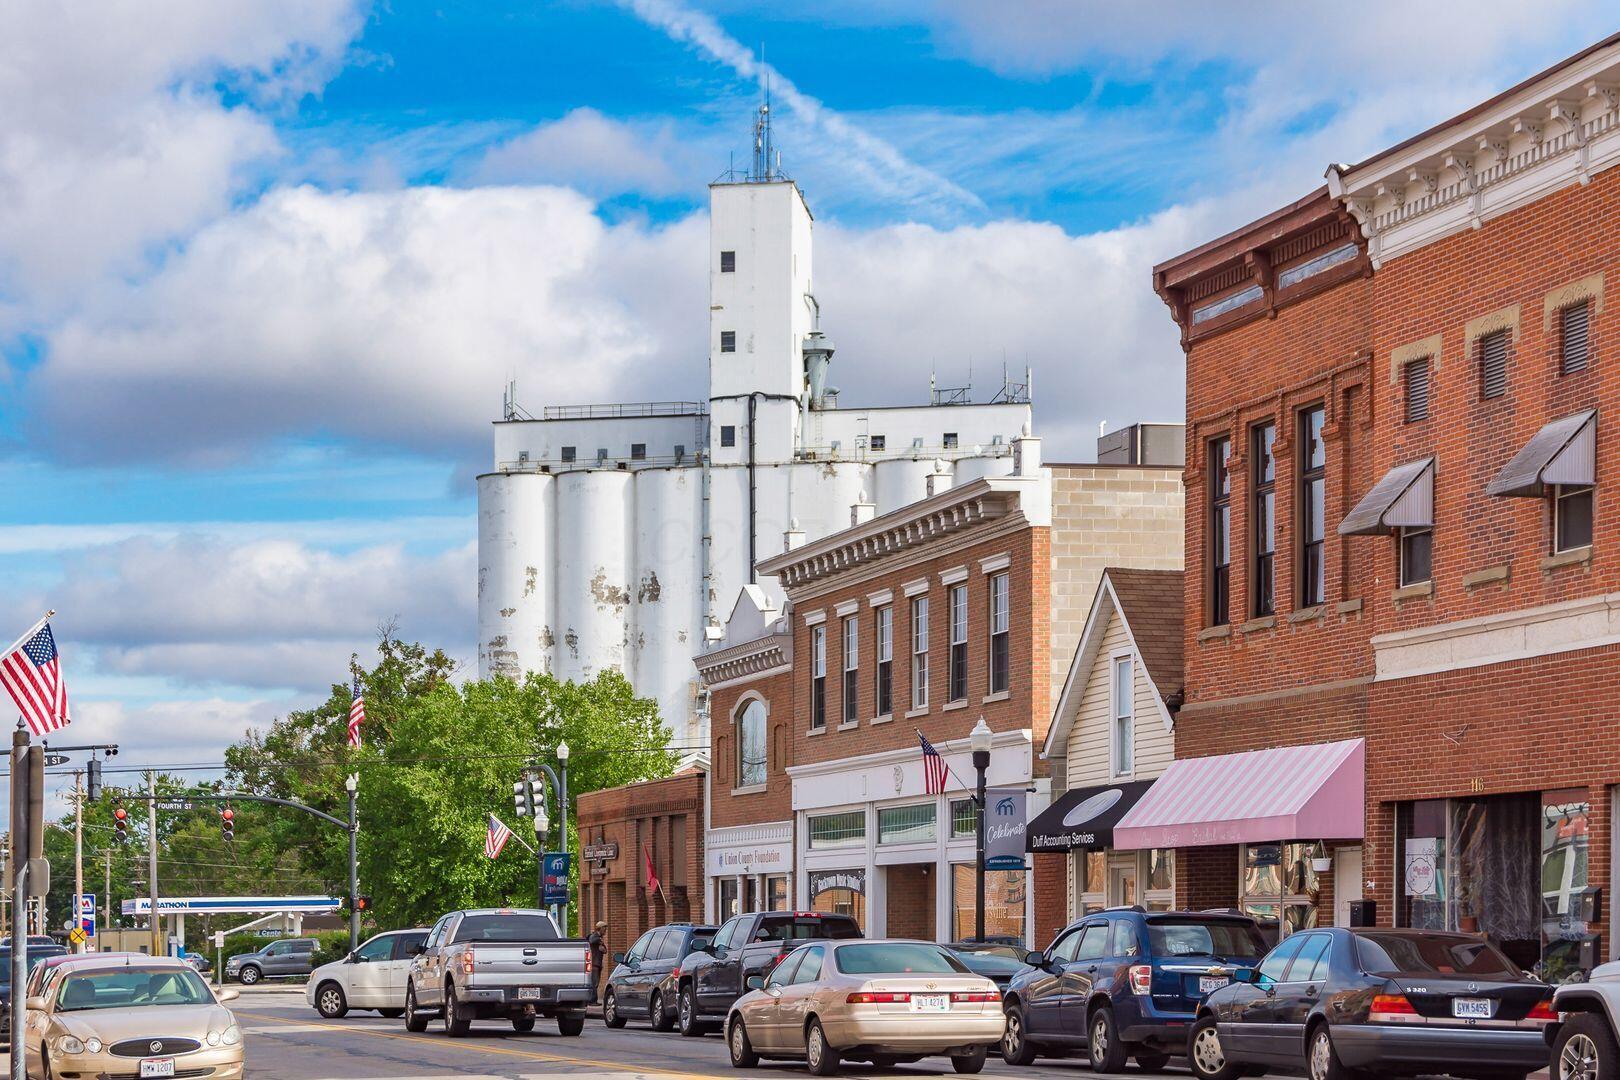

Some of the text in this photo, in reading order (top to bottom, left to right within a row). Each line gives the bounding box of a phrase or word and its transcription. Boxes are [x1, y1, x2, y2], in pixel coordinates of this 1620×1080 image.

[1472, 778, 1484, 792] 116
[987, 823, 1025, 844] Celebrate
[1033, 832, 1095, 848] Duff Accounting Services
[725, 850, 780, 866] Union County Foundation
[157, 1063, 172, 1072] 1207
